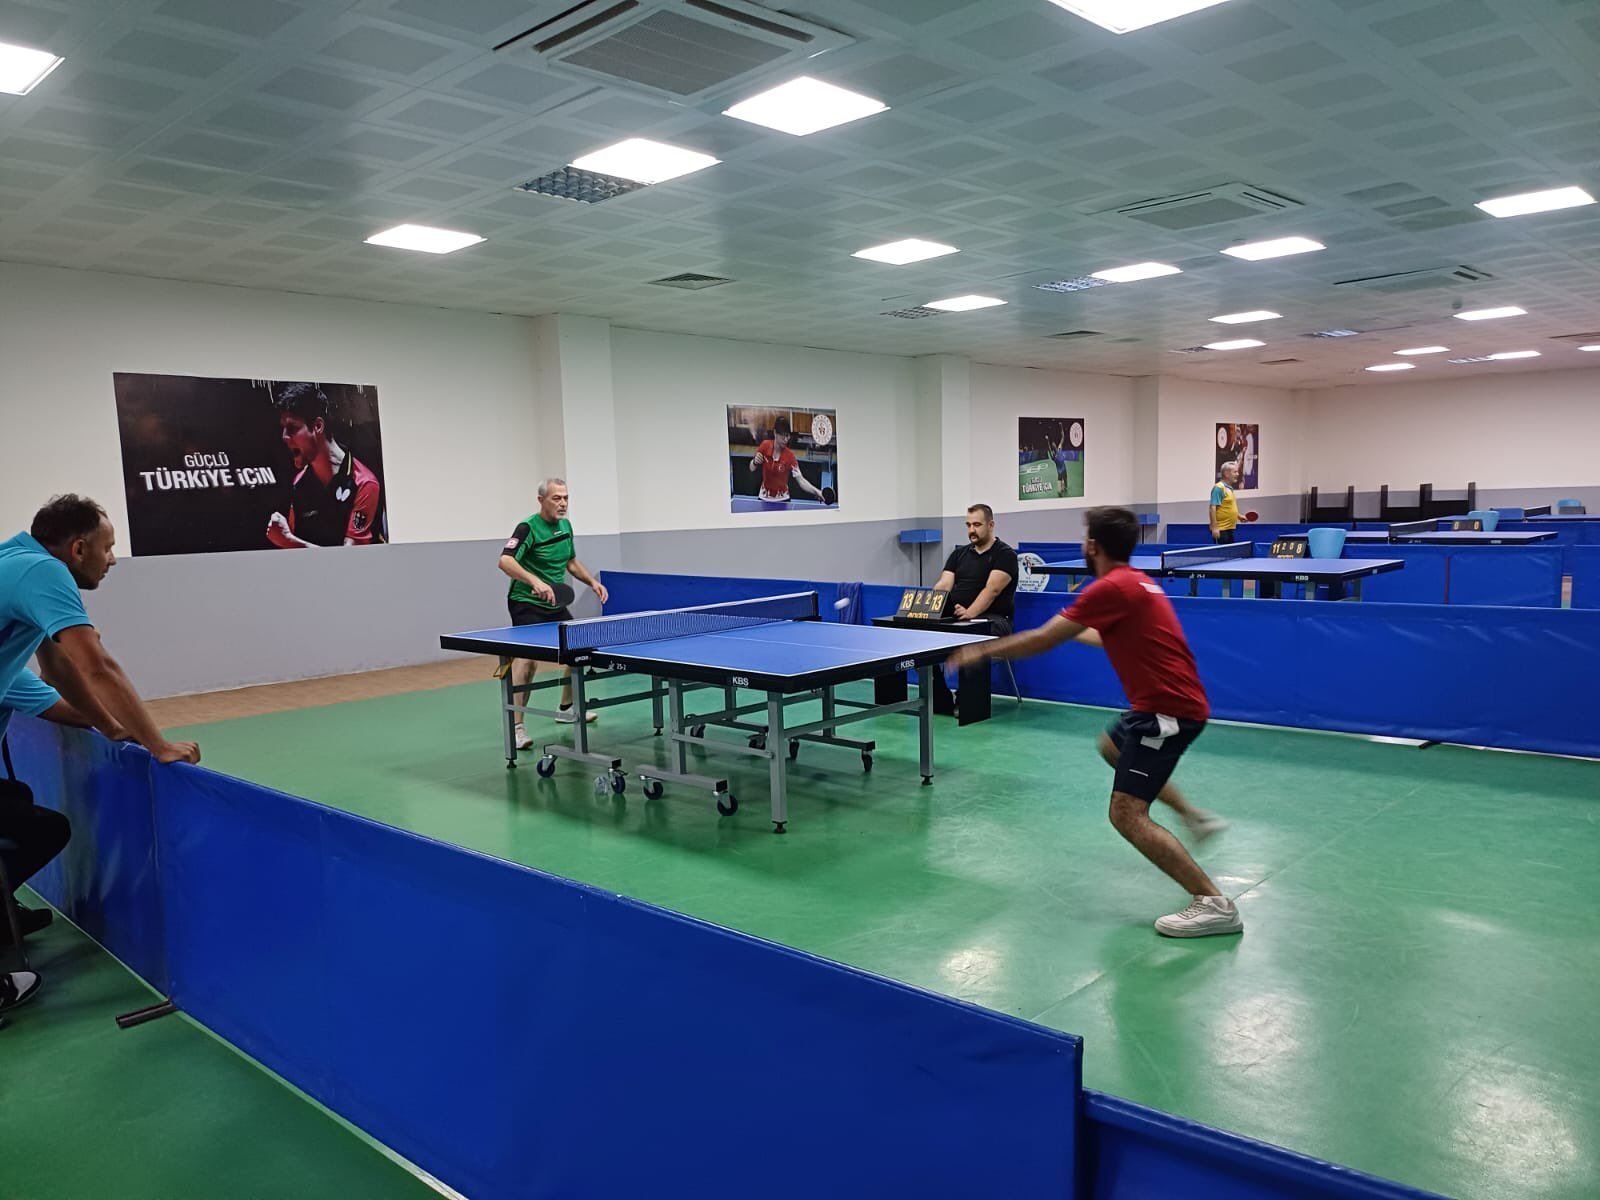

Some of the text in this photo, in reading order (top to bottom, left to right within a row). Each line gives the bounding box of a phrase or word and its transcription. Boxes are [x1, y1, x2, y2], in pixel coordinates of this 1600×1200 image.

[184, 452, 230, 469] GÜÇLÜ
[1272, 543, 1281, 554] 11
[1296, 543, 1303, 554] 8
[902, 591, 944, 611] 13 2 2 13
[900, 658, 915, 669] KBS
[733, 673, 749, 686] KBS
